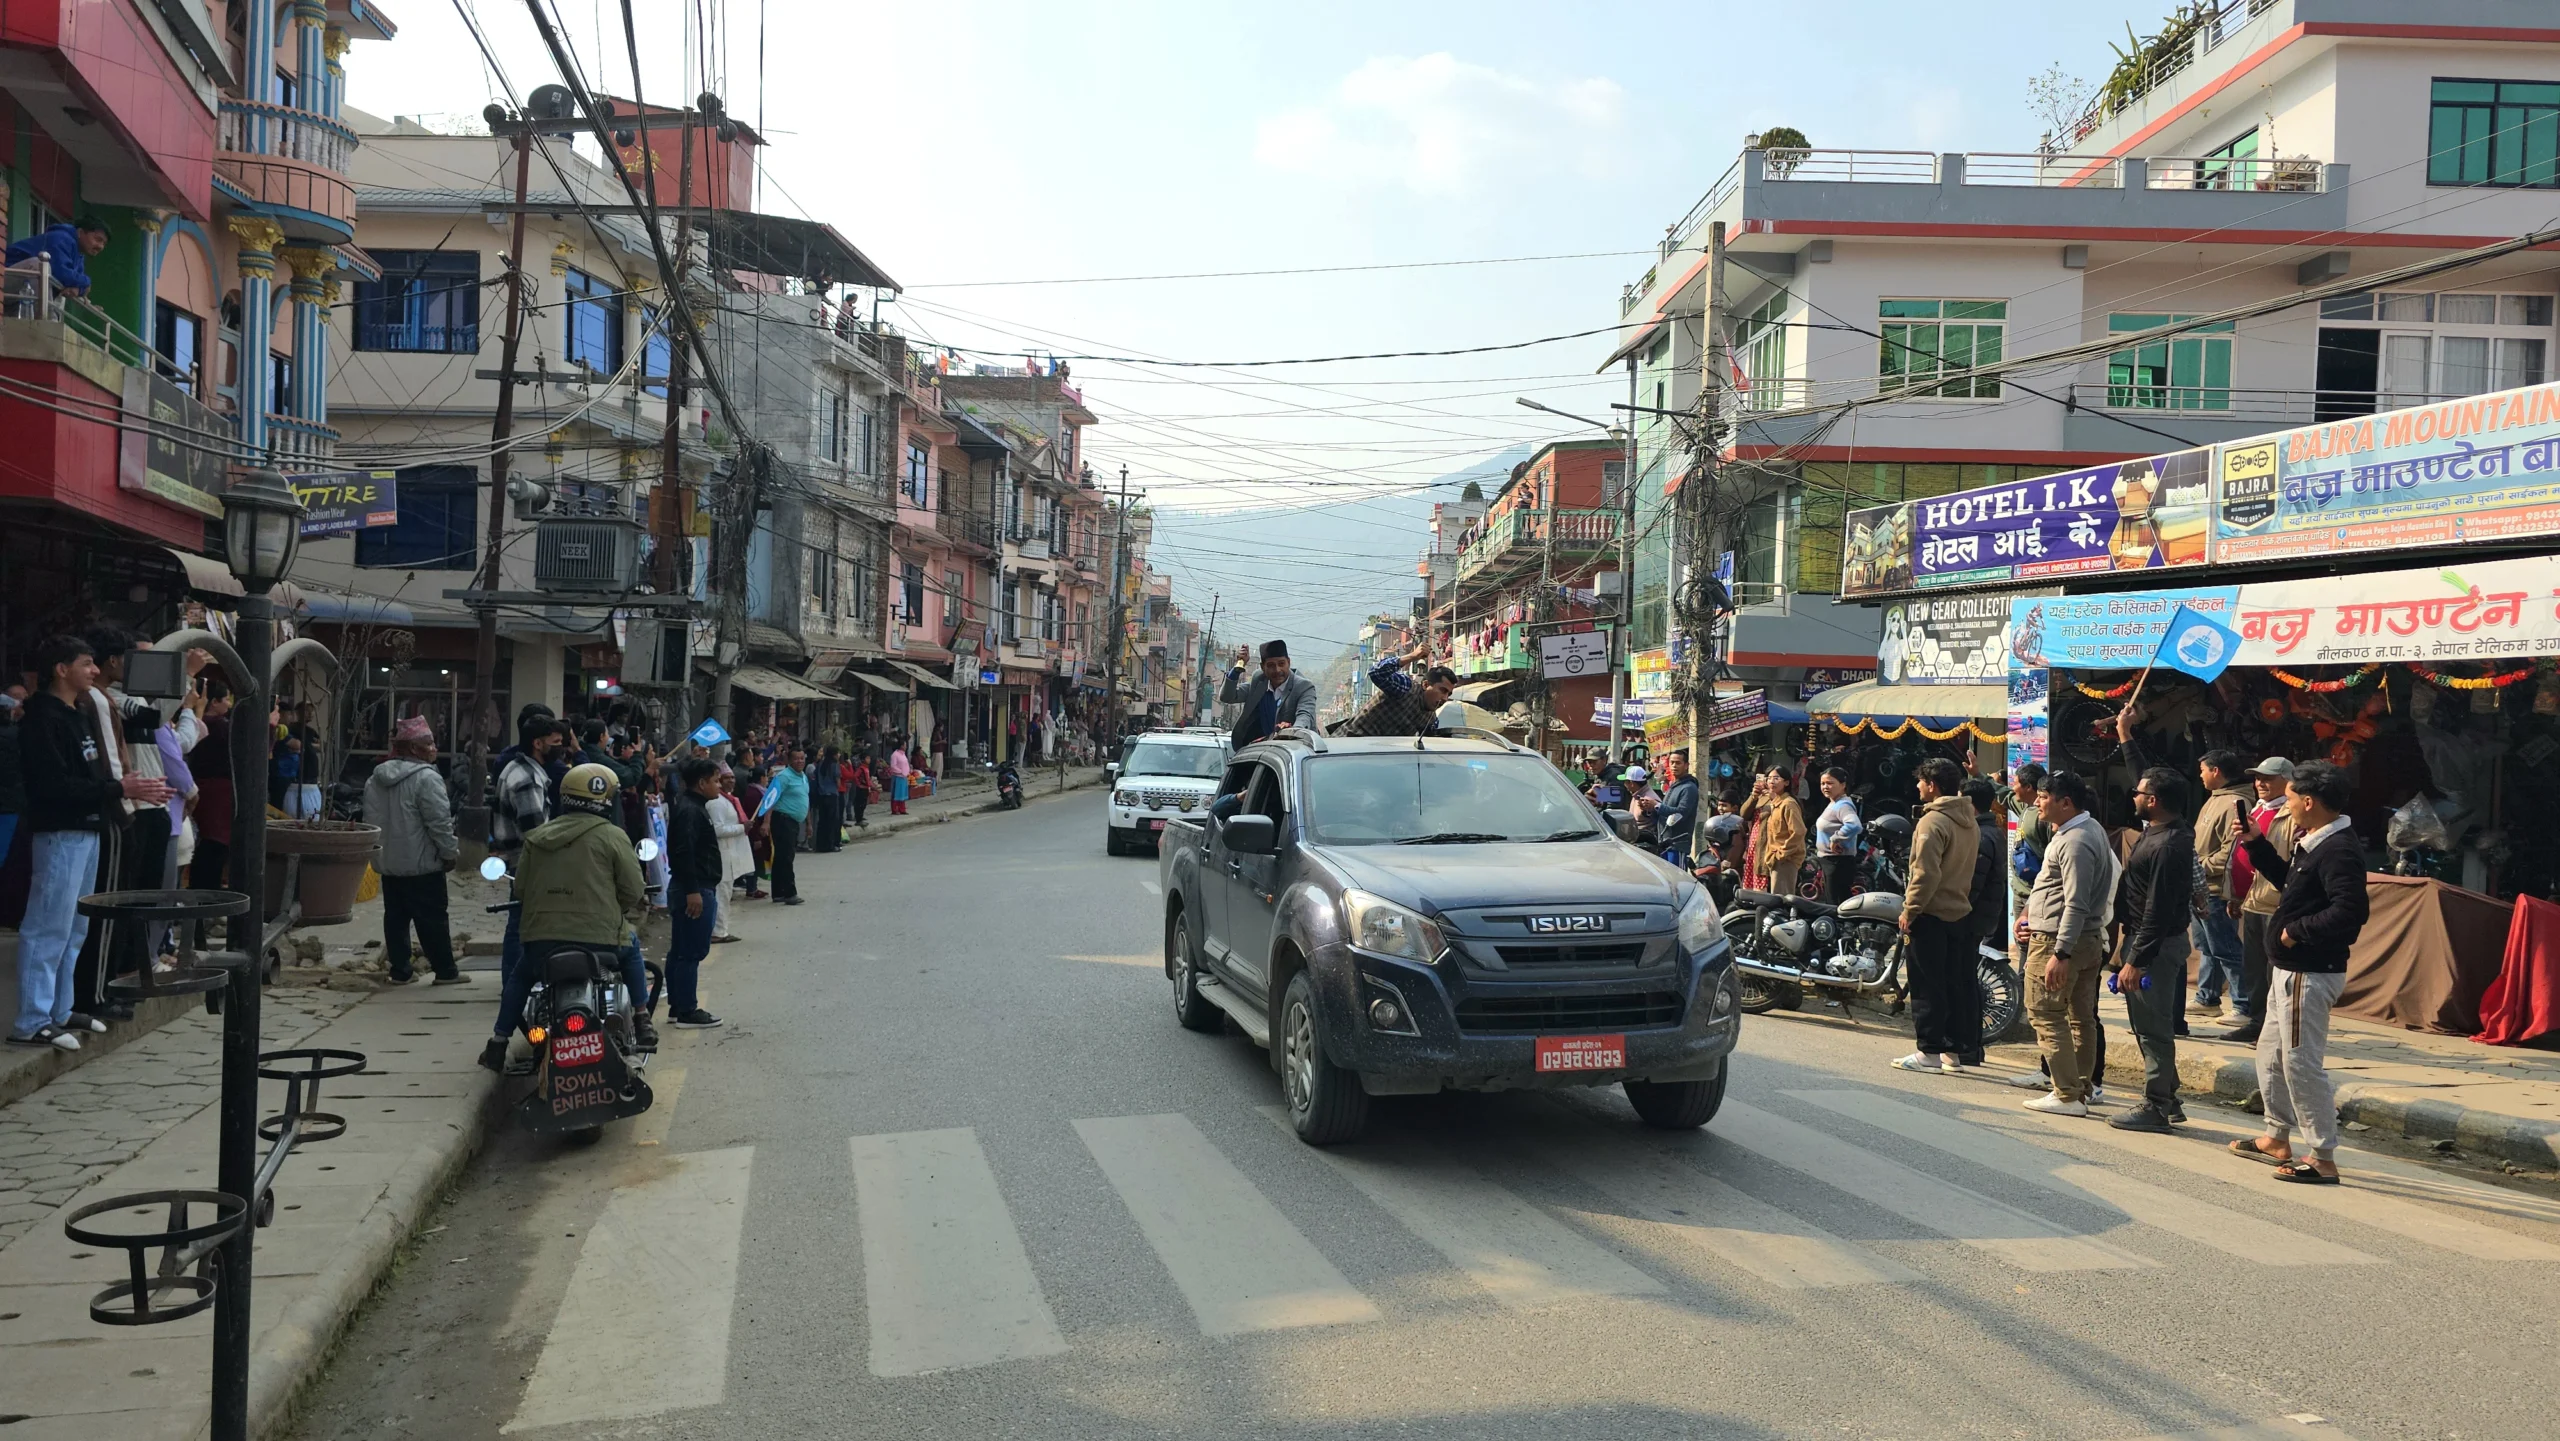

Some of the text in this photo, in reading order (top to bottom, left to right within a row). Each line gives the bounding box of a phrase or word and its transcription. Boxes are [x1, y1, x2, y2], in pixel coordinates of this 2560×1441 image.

[2288, 388, 2560, 464] BAJRA MOUNTAIN
[2283, 469, 2346, 509] बज्र
[2352, 441, 2514, 493] माउण्टेन
[2229, 476, 2269, 496] BAJRA
[331, 507, 346, 519] Wear
[1924, 475, 2108, 530] HOTEL I.K.
[2465, 514, 2522, 527] Whatsapp:
[2465, 519, 2560, 537] Viber: 98432536
[561, 545, 588, 557] NEEK
[1921, 534, 1979, 572] होटल
[2347, 539, 2364, 548] TIK
[1907, 595, 2025, 622] NEW GEAR COLLECTI
[2049, 603, 2071, 619] यहाँ
[2074, 602, 2102, 619] हरेक
[2107, 598, 2169, 615] किसिमको
[2061, 622, 2108, 638] माउण्टेन
[2112, 621, 2146, 637] बाईक
[2241, 608, 2316, 657] बज्र
[2066, 644, 2096, 660] सुपथ
[2099, 643, 2145, 661] मुल्यमा
[2317, 646, 2370, 660] नीलकण्ठ
[2432, 642, 2468, 657] नेपाल
[2474, 637, 2528, 653] टेलिकम
[1532, 916, 1604, 932] ISUZU
[555, 1071, 606, 1095] ROYAL
[552, 1088, 617, 1117] ENFIELD
